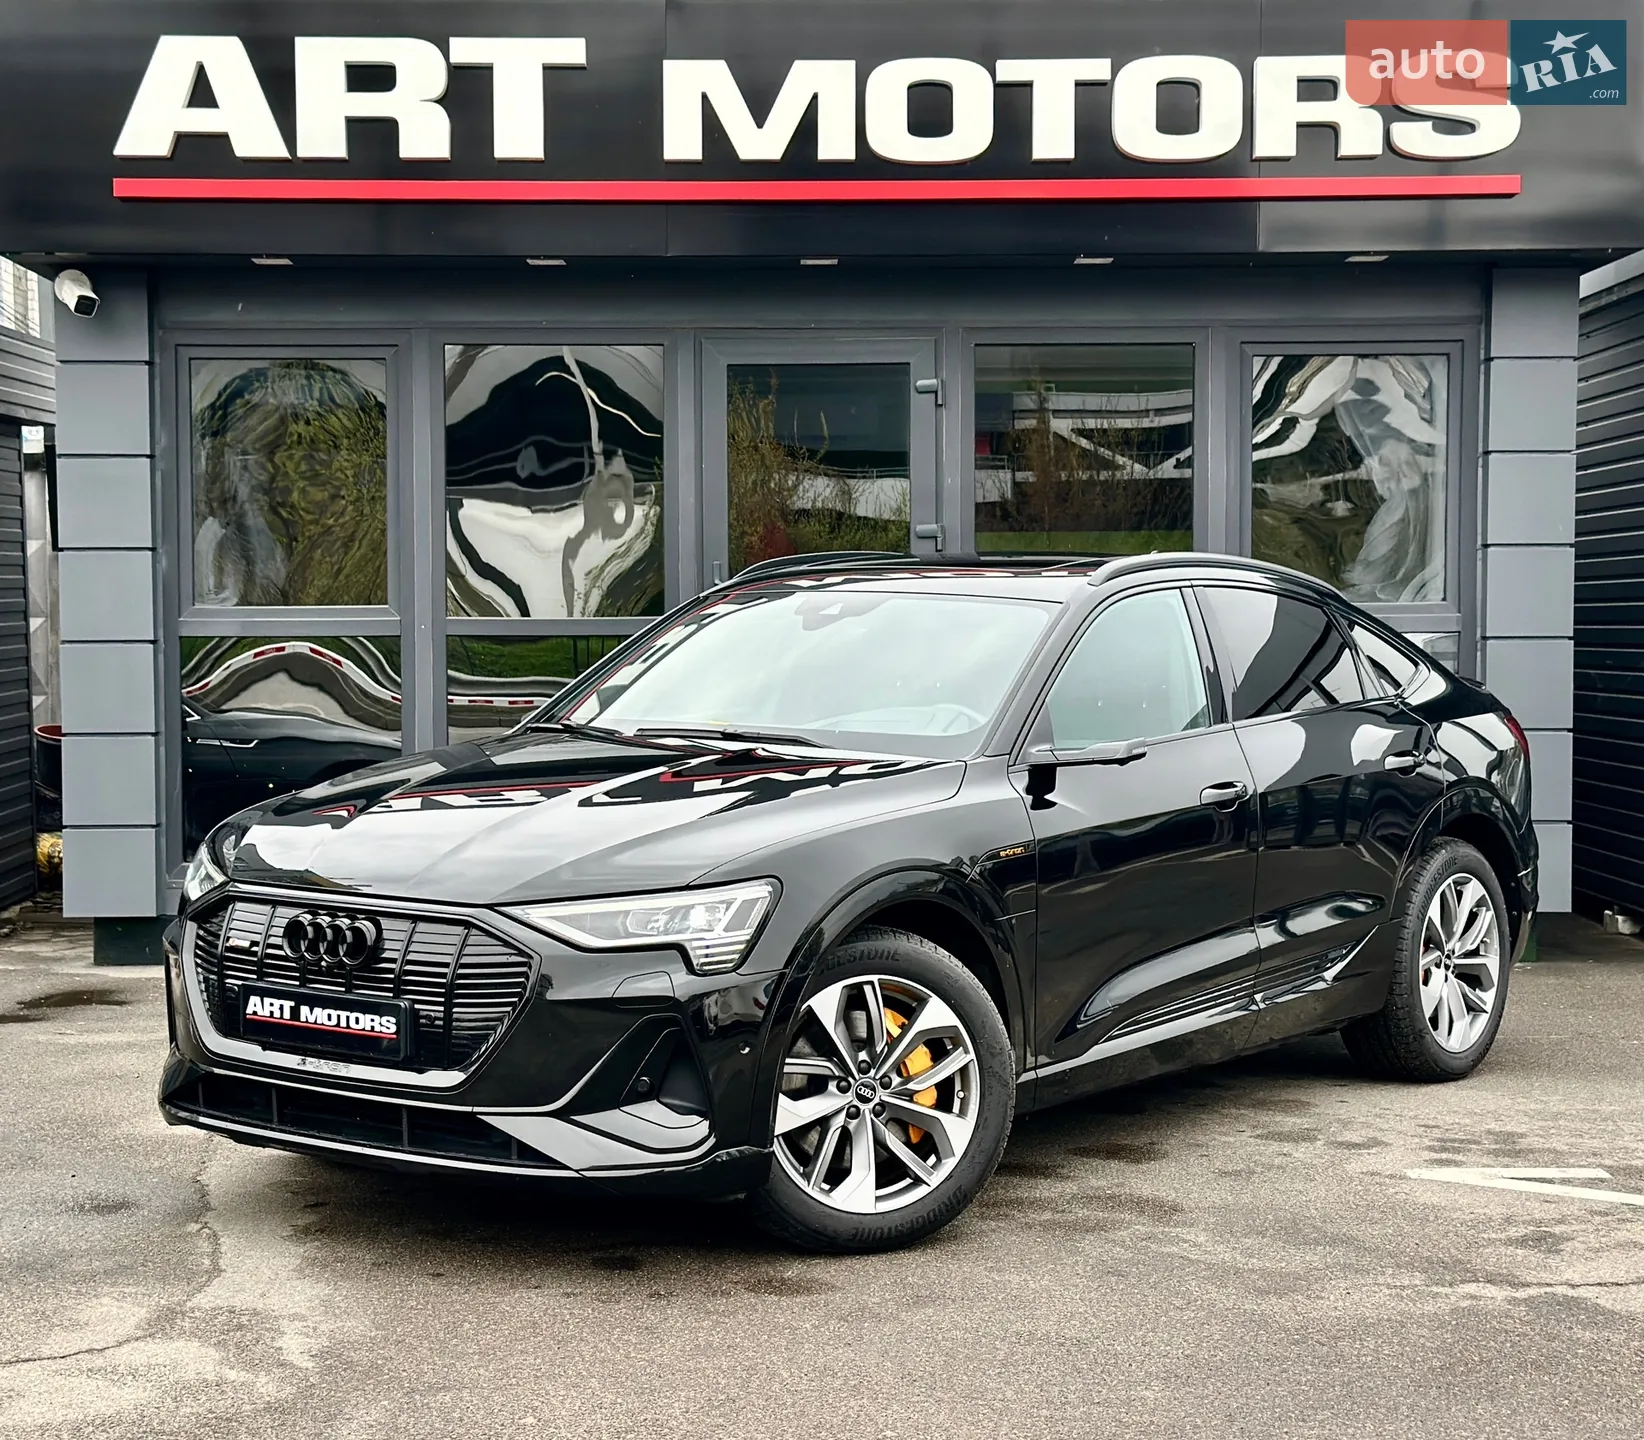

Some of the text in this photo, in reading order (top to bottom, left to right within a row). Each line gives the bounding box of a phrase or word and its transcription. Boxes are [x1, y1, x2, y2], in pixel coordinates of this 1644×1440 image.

[113, 35, 1522, 163] ART MOTORS
[246, 995, 397, 1034] ART MOTORS
